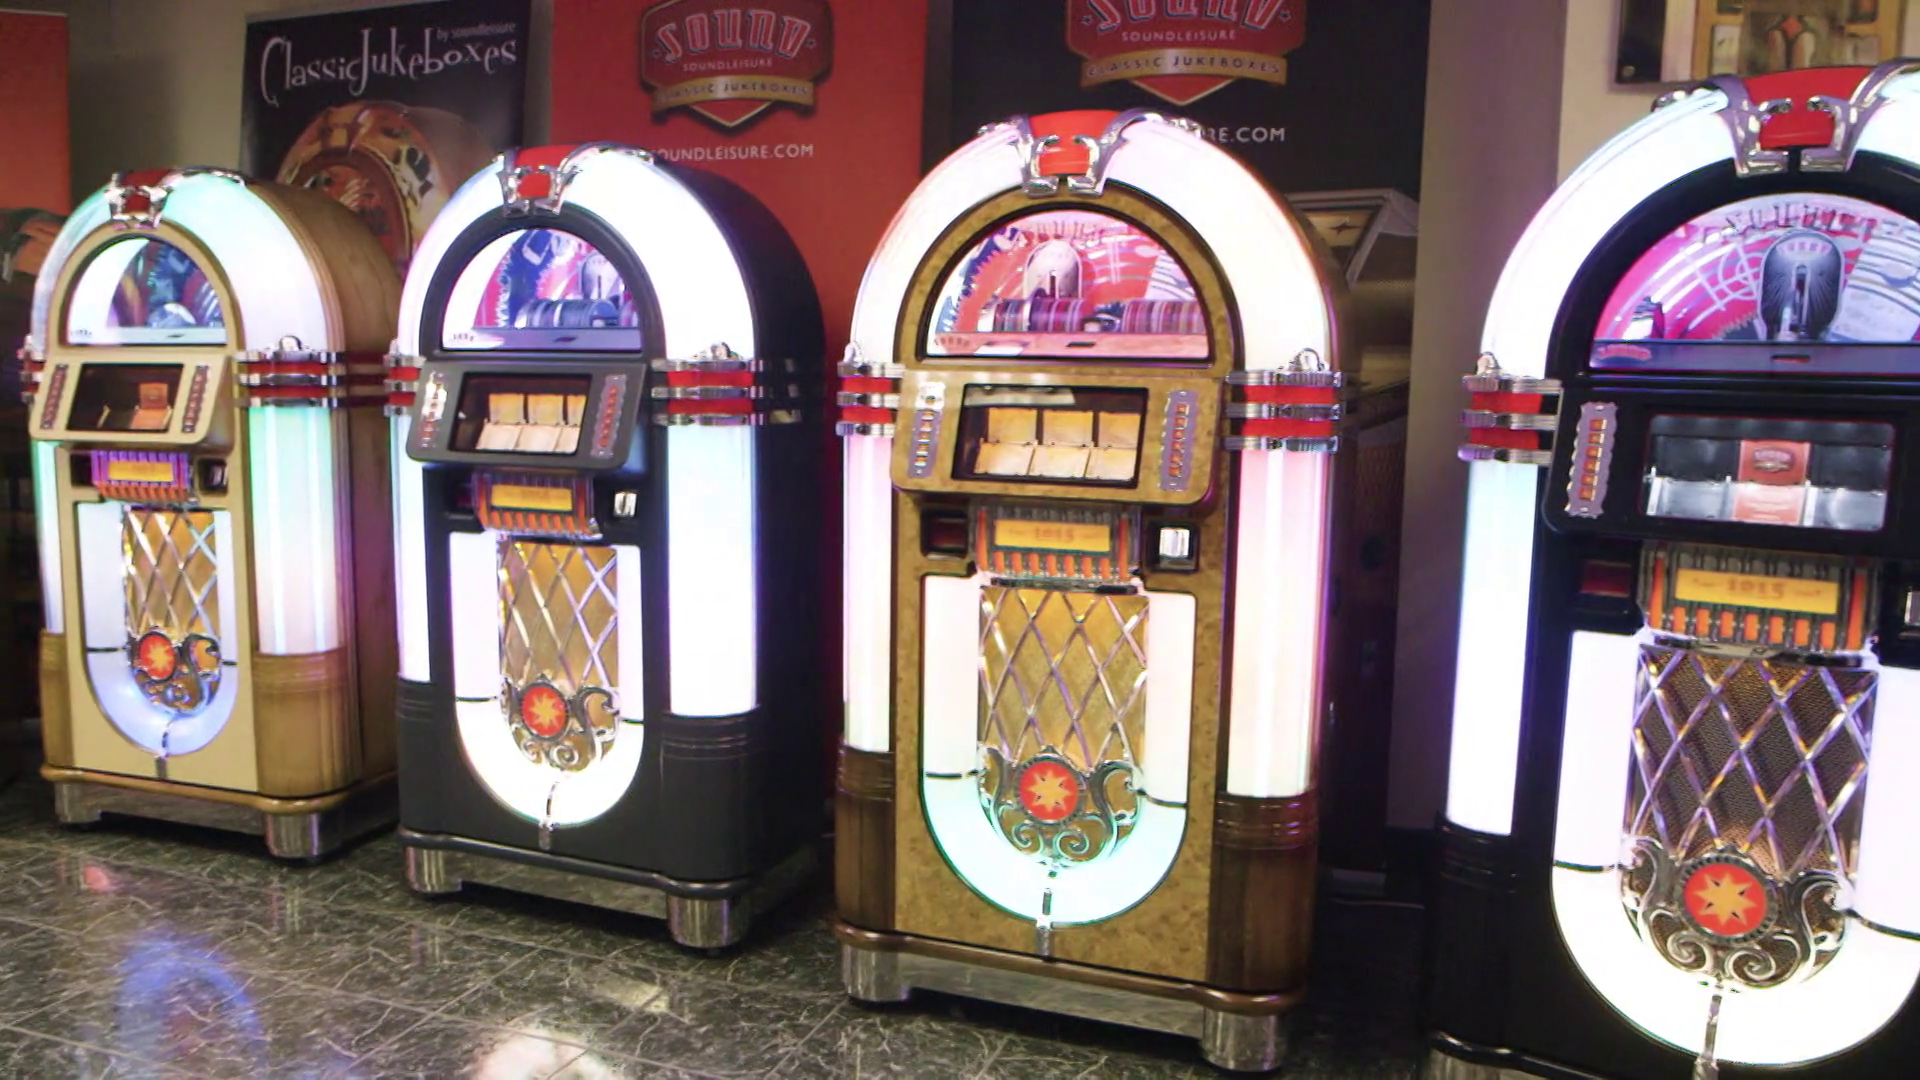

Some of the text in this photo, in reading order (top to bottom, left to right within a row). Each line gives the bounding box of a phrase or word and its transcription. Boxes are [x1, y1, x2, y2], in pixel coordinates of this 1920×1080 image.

[657, 9, 811, 63] SOUND
[1121, 30, 1237, 43] SOUNDLEISURE
[683, 60, 773, 72] SOUNDLEISURE
[653, 144, 814, 162] OUNDLEISURE.COM
